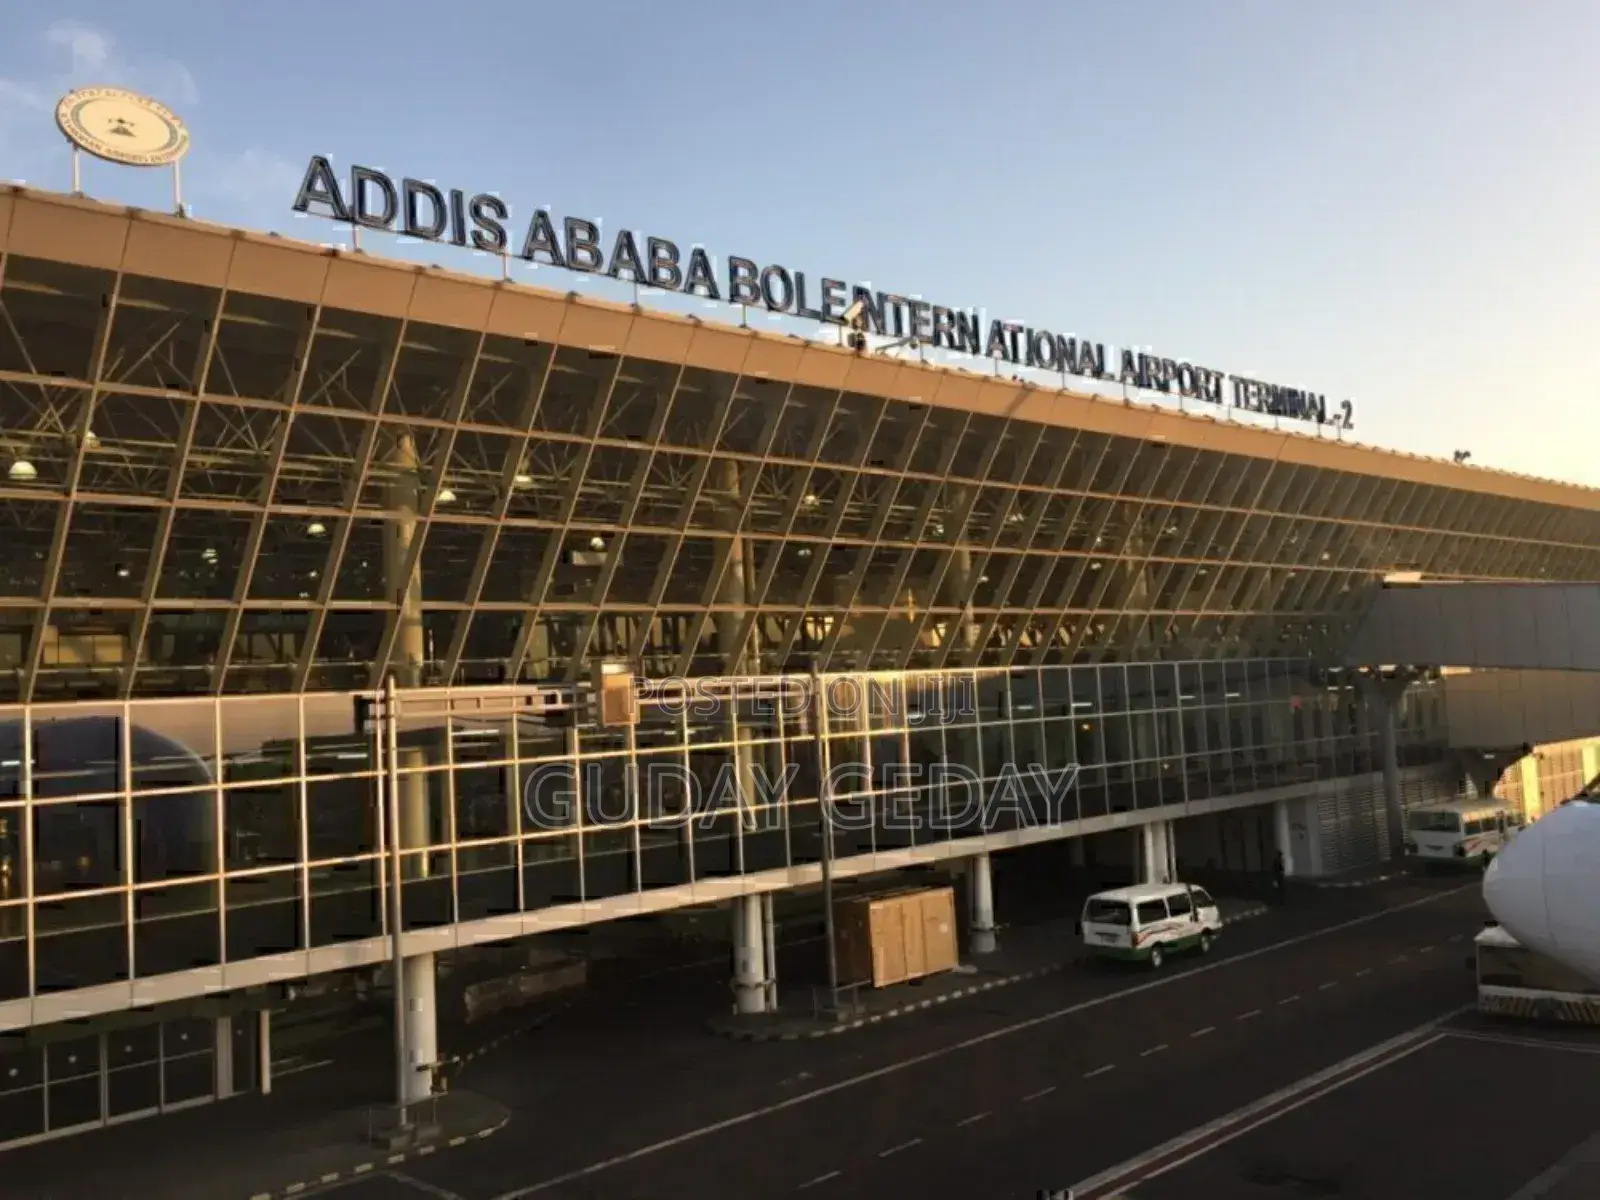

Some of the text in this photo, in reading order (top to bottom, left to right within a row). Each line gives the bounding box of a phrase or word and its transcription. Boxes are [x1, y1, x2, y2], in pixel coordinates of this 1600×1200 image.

[292, 155, 508, 255] ADDIS
[521, 209, 720, 300] ABABA
[728, 255, 847, 325] BOLE
[1119, 348, 1224, 405] AIRPORT
